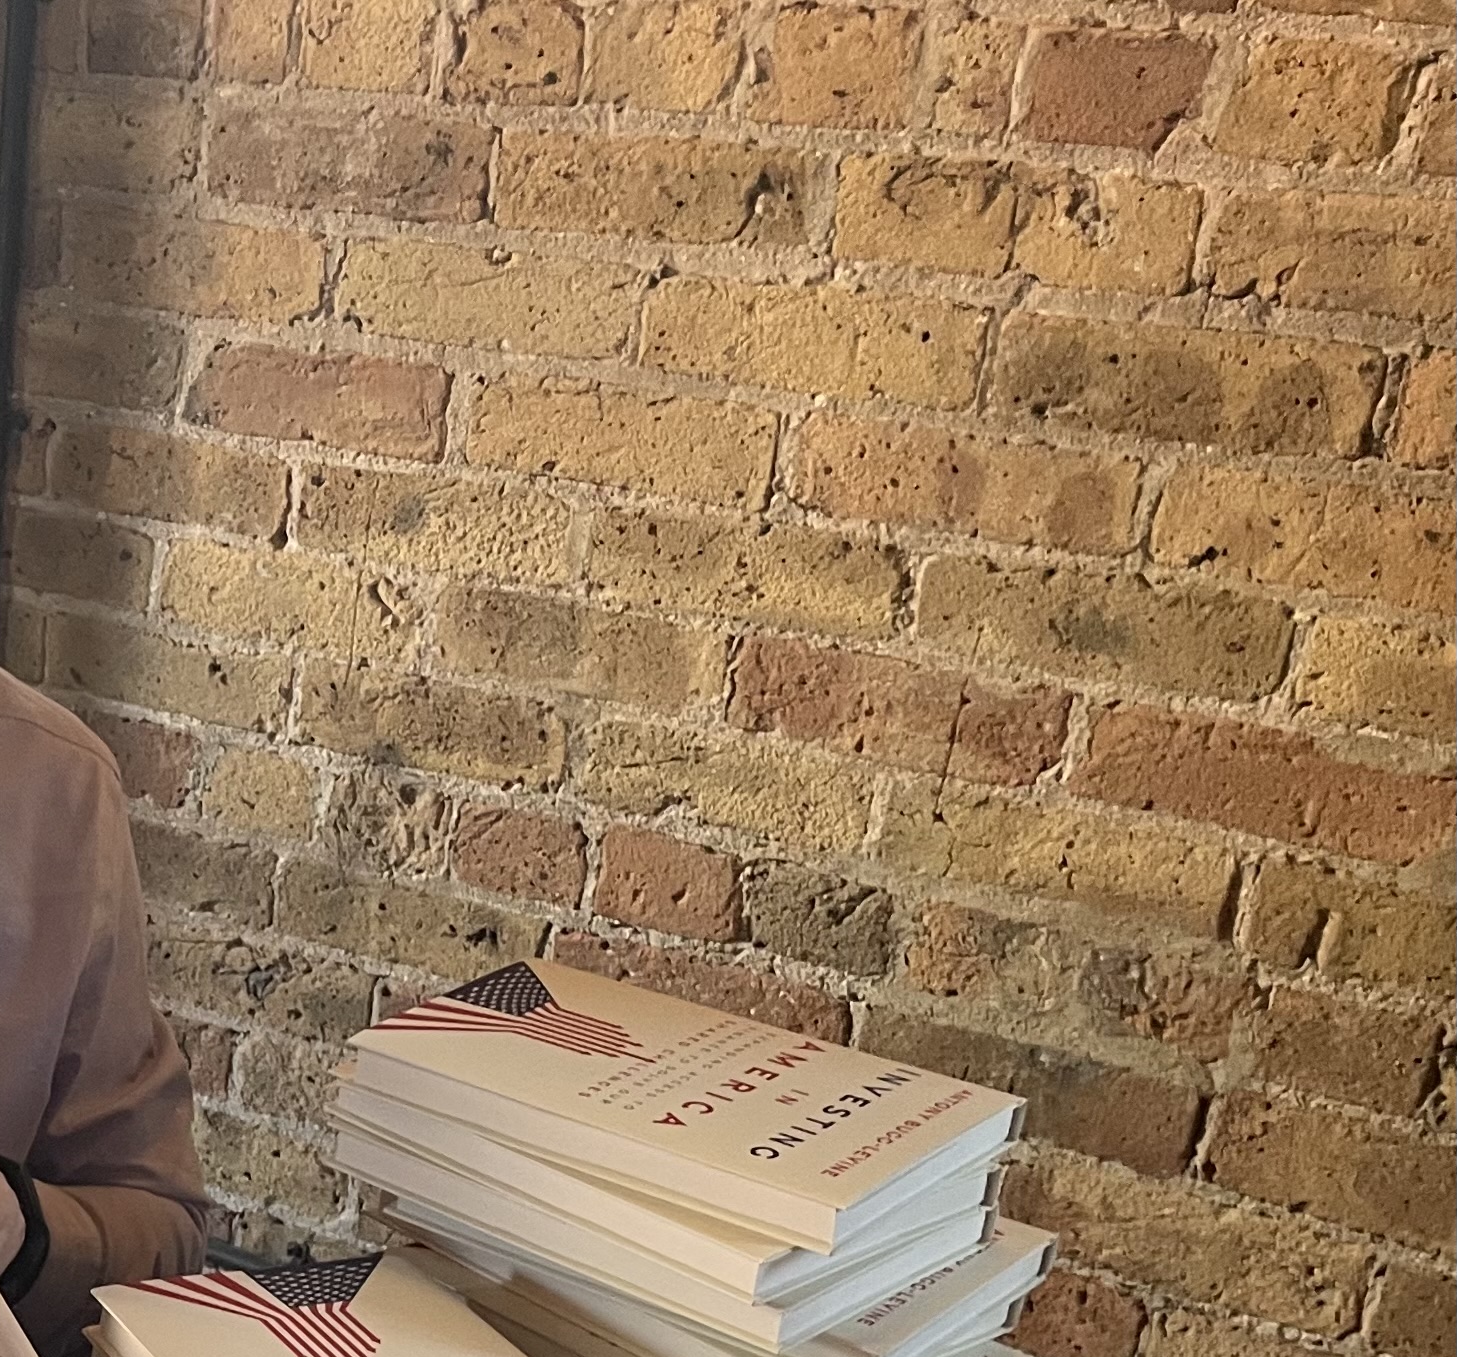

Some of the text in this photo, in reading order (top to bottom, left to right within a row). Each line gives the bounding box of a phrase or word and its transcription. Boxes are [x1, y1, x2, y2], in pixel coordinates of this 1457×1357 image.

[653, 1040, 828, 1128] AMERICA
[750, 1067, 922, 1160] INVESTING
[775, 1088, 810, 1106] IN
[918, 1089, 974, 1121] ANTONY
